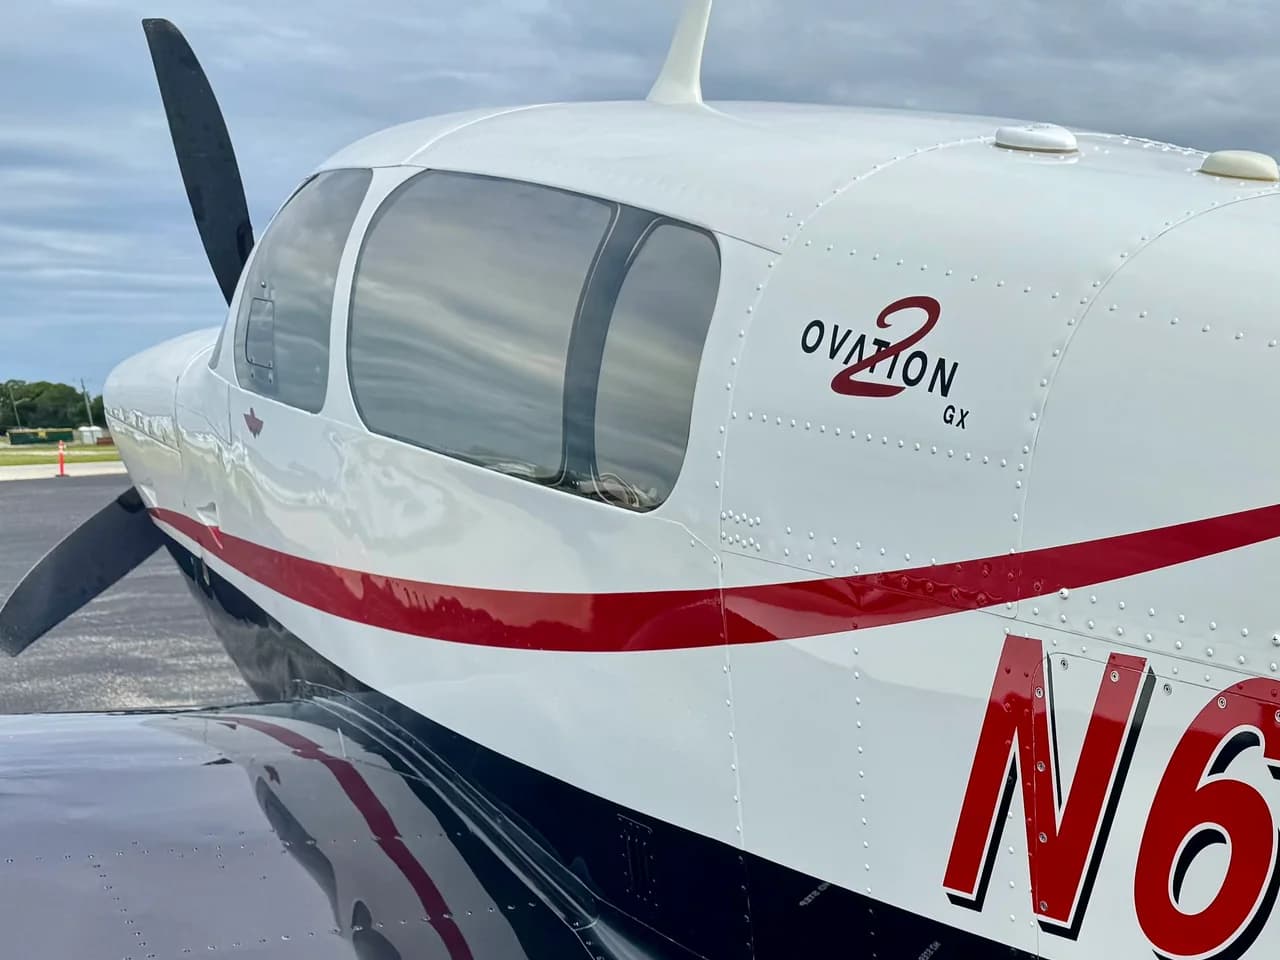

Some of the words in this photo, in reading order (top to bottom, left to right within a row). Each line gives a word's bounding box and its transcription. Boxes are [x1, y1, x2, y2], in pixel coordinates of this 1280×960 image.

[801, 319, 959, 398] OVATION
[830, 295, 942, 398] 2
[943, 404, 969, 429] GX
